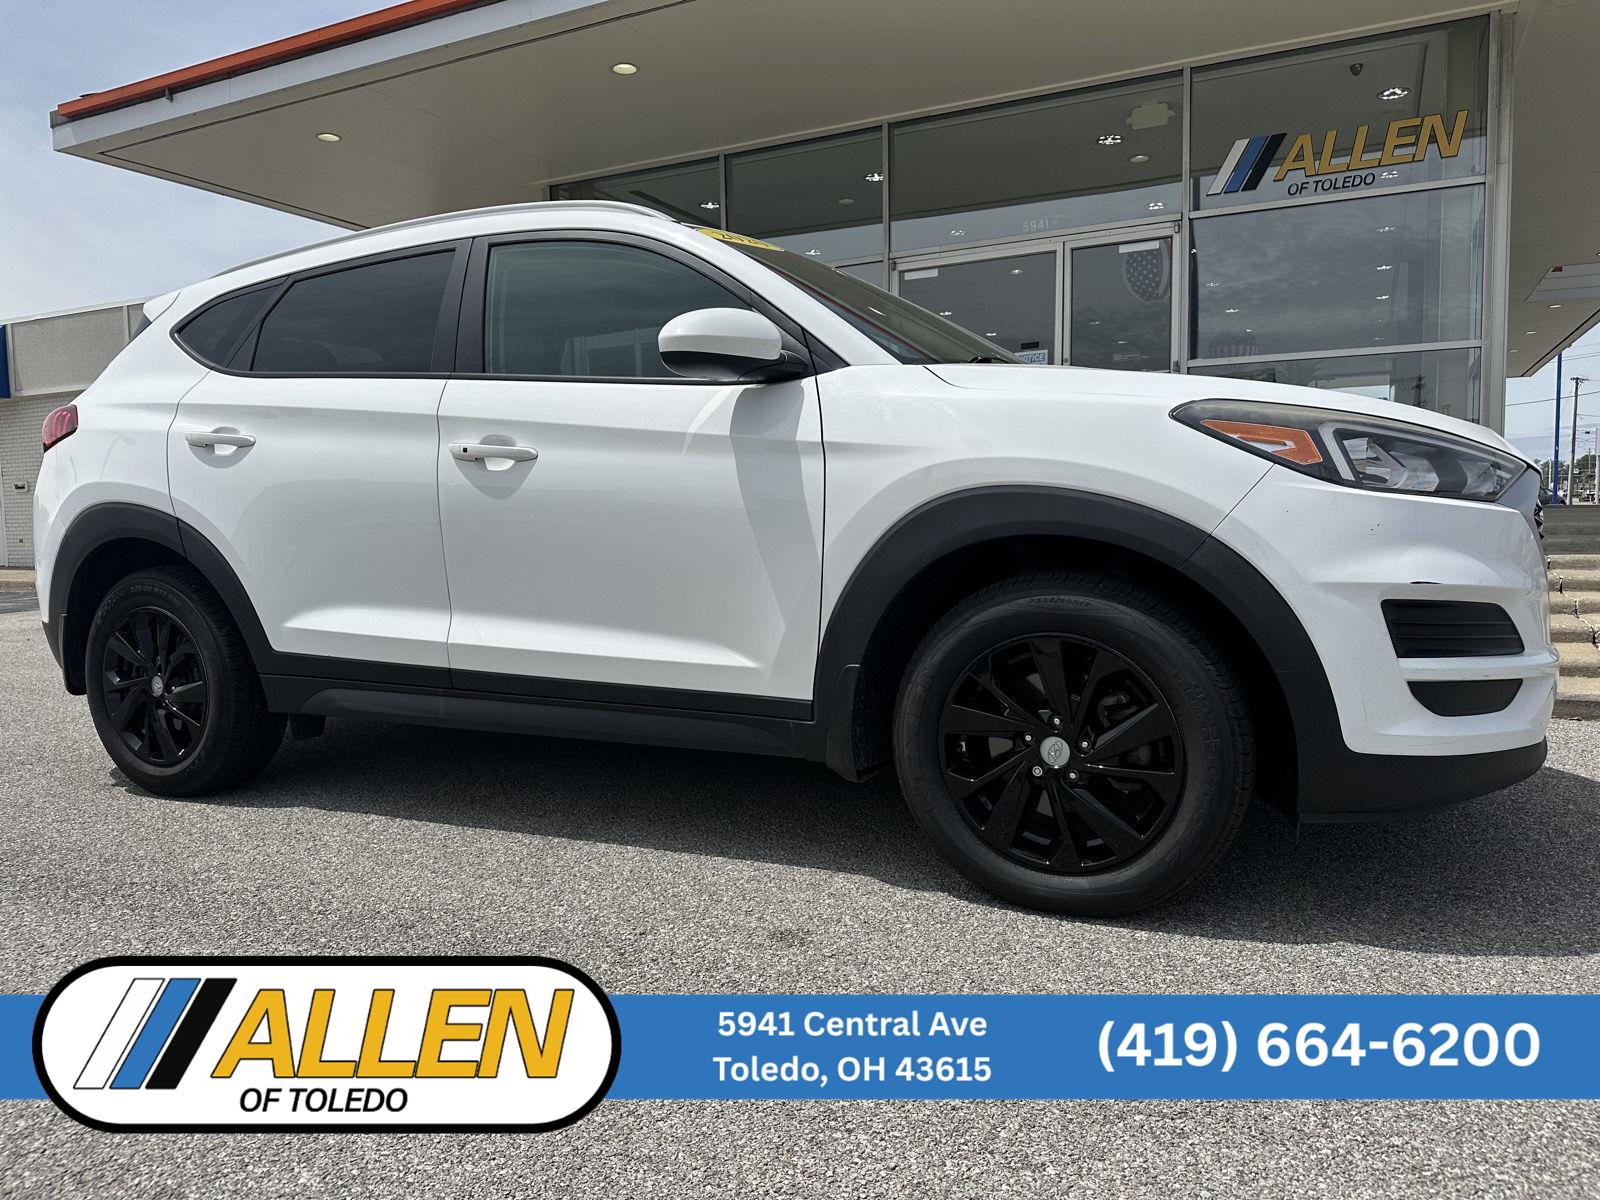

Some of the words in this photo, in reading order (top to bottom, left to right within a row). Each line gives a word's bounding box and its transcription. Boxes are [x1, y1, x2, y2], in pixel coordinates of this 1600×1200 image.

[1273, 110, 1469, 182] ALLEN
[1287, 180, 1308, 196] OF
[1312, 172, 1376, 194] TOLEDO
